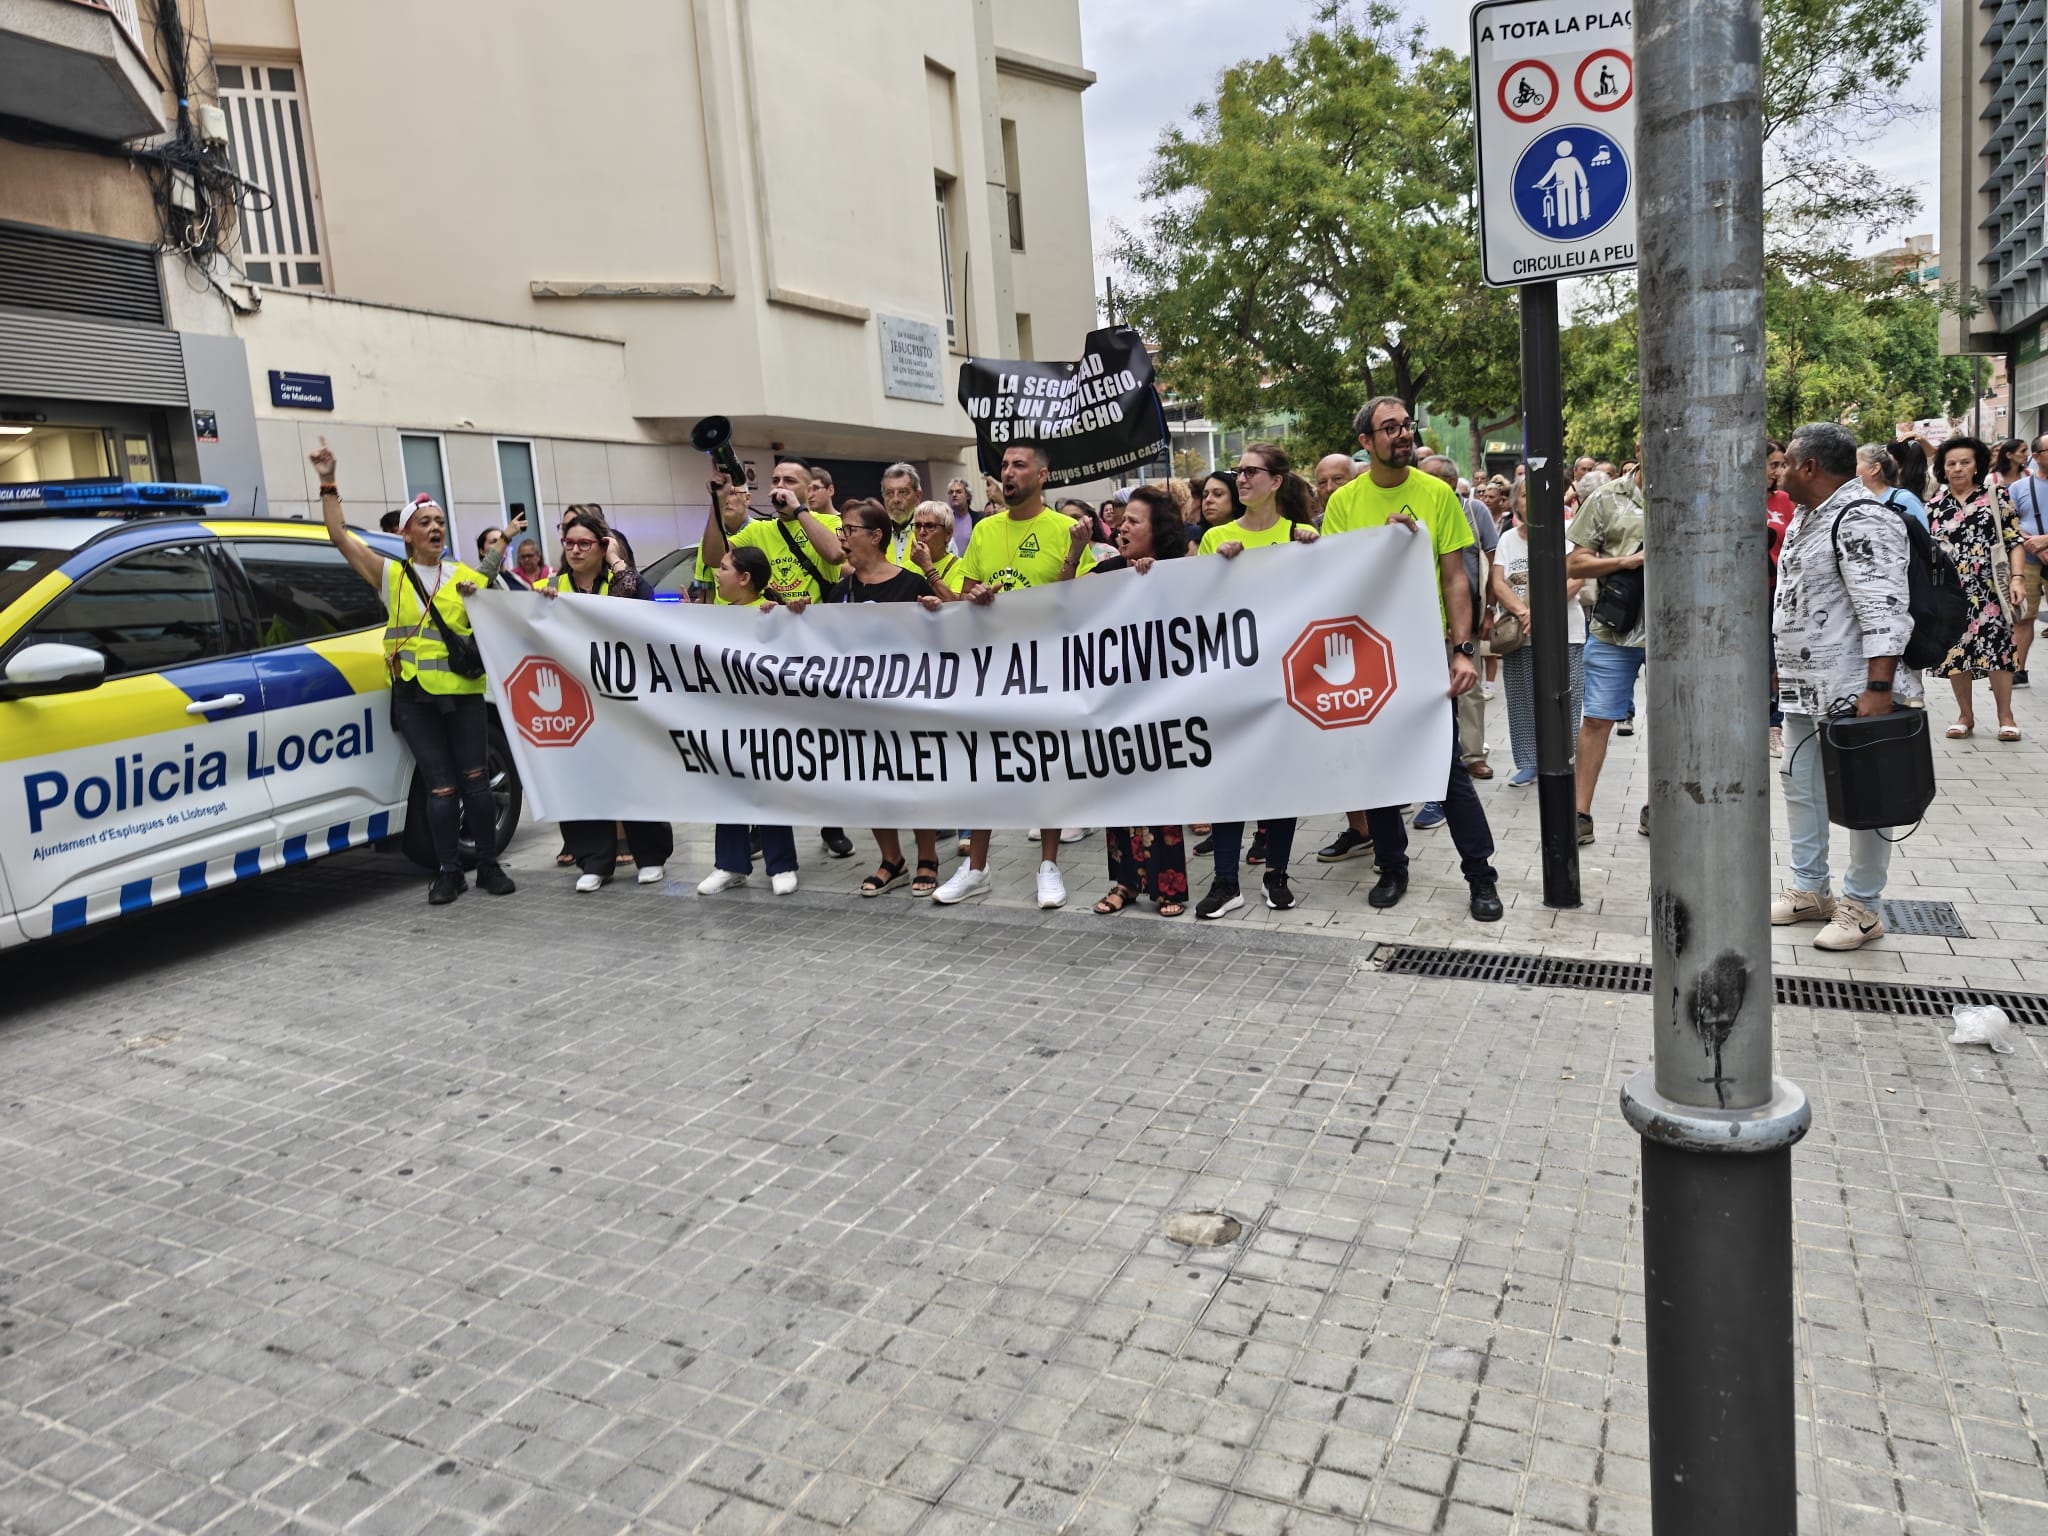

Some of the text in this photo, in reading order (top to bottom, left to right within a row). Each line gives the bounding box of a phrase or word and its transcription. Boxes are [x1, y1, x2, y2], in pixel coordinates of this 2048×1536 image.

[1480, 10, 1632, 43] A TOTA LA PLAÇ
[1513, 243, 1634, 275] CIRCULEU A PEU
[890, 339, 933, 359] JESUCRISTO
[280, 382, 302, 392] Carrer
[998, 353, 1104, 398] LA SEGURAD
[281, 391, 322, 403] de Maladeta
[967, 397, 991, 419] NO
[994, 396, 1015, 419] ES
[1017, 398, 1046, 418] UN
[991, 401, 1124, 443] ES UN DERECHO
[1046, 467, 1082, 482] ECINOS
[1083, 464, 1096, 477] DE
[1096, 451, 1137, 473] PUBILLA
[0, 487, 41, 500] CIA LOCAL
[782, 590, 810, 598] SSERIA
[590, 608, 1260, 700] NO A LA INSEGURIDAD Y AL INCIVISMO
[1316, 687, 1374, 712] STOP
[531, 714, 576, 733] STOP
[669, 716, 1213, 783] EN L'HOSPITALET Y ESPLUGUES
[23, 707, 375, 834] Policia Local
[33, 801, 227, 861] Ajuntament d'Esplugues de Llobregat
